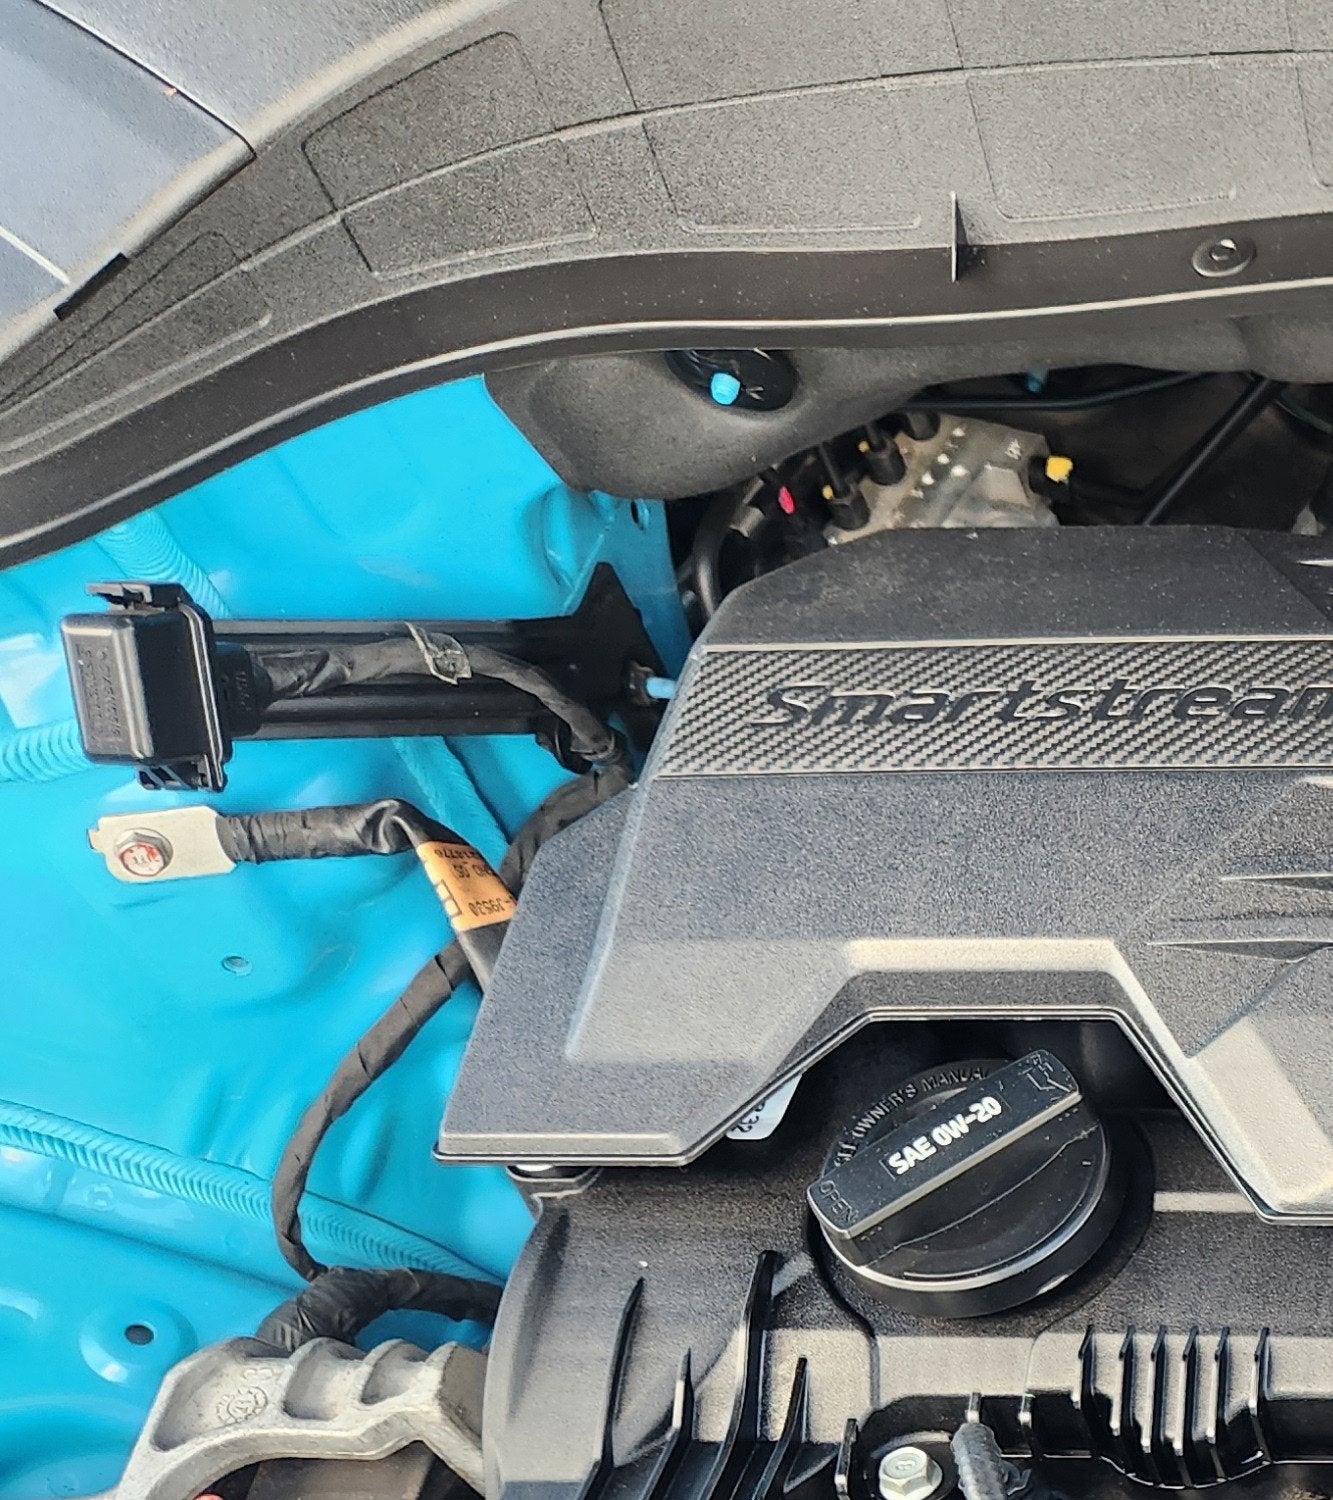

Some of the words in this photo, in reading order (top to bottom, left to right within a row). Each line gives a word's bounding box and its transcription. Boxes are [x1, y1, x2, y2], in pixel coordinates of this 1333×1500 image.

[888, 1136, 937, 1175] SAE
[932, 1096, 1002, 1147] 0W-20
[819, 1180, 852, 1223] OPEN
